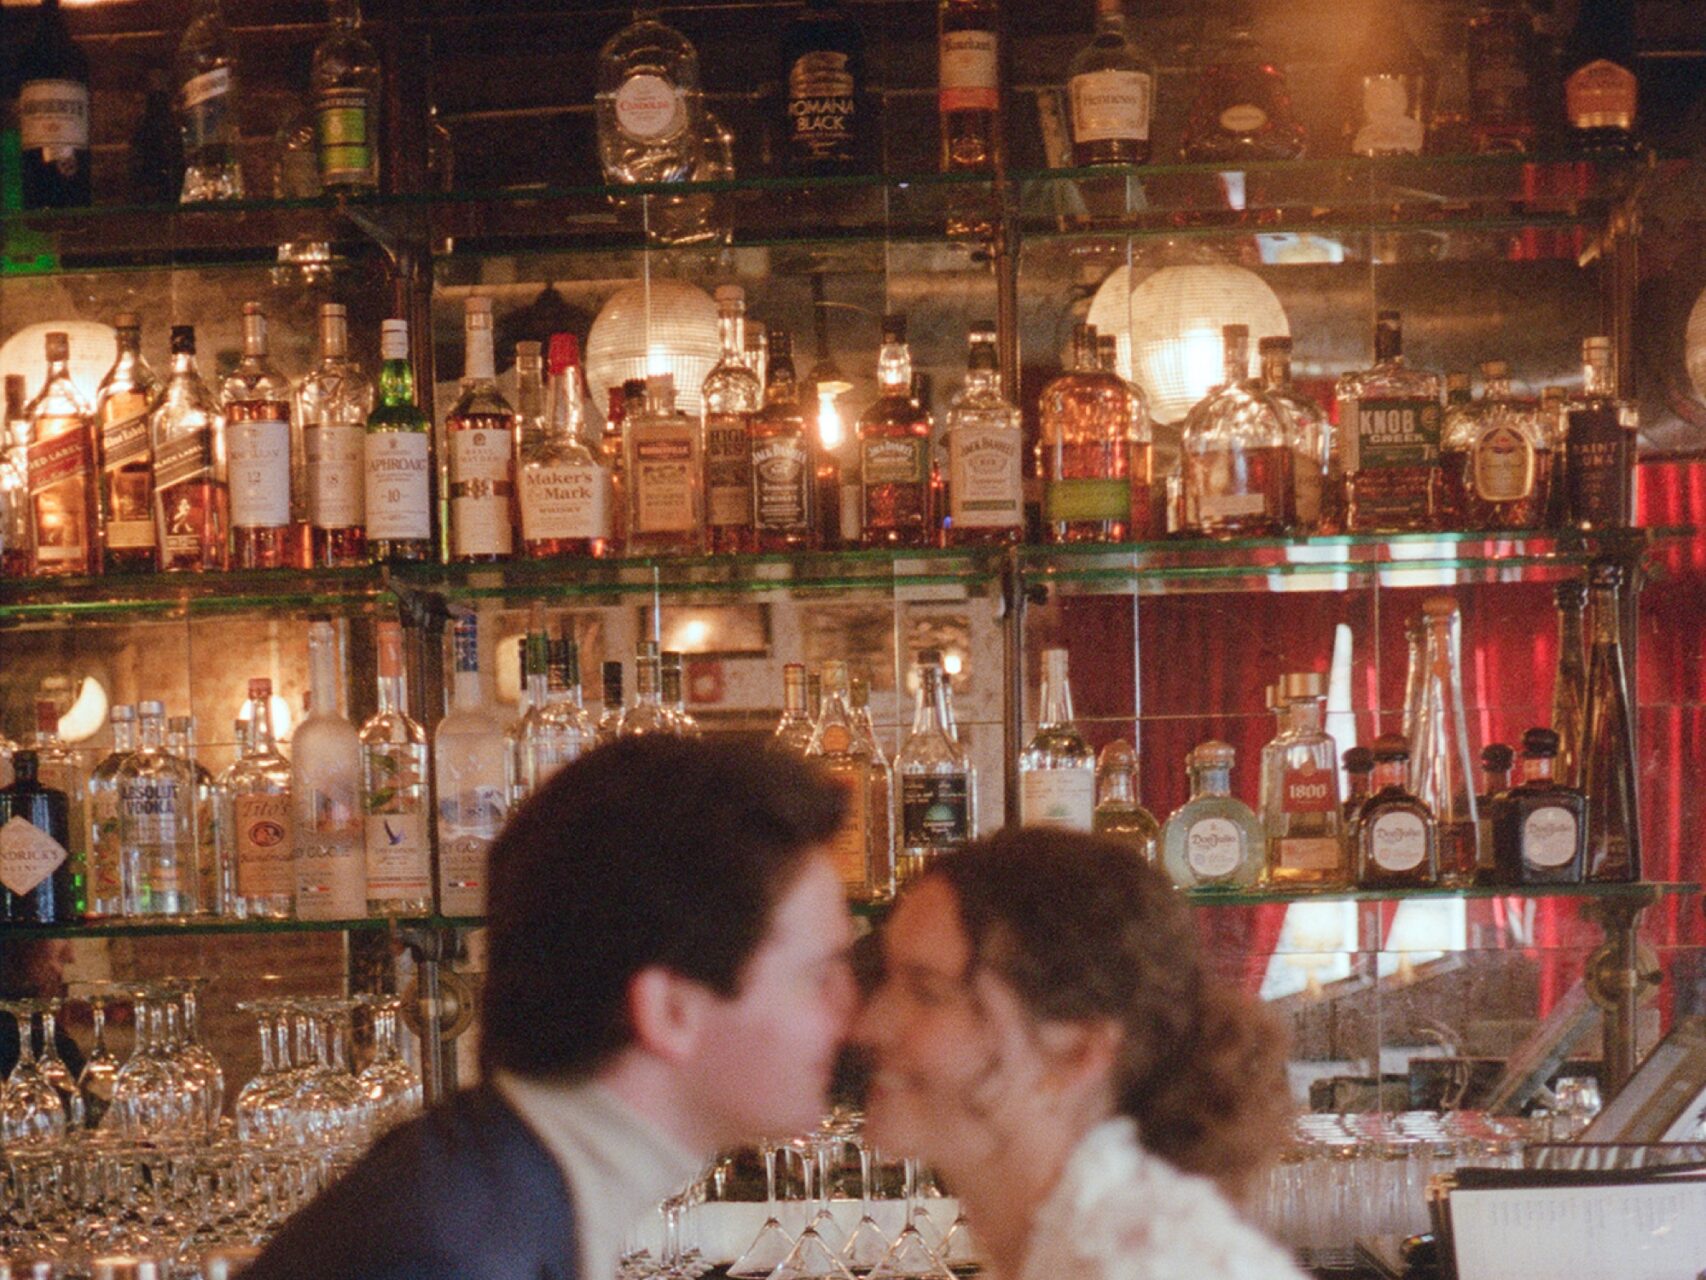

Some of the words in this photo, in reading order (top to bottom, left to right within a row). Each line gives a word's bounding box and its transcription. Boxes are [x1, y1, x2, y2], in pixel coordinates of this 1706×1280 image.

[797, 116, 844, 131] BLACK
[1360, 409, 1415, 434] KNOB
[1370, 433, 1425, 444] CREEK
[369, 458, 426, 472] APHROAIG
[526, 472, 593, 485] Maker's
[387, 488, 401, 503] 10
[544, 486, 593, 500] Mark
[1289, 783, 1327, 800] 1800
[126, 800, 175, 815] VODKA
[242, 799, 291, 818] Tito's
